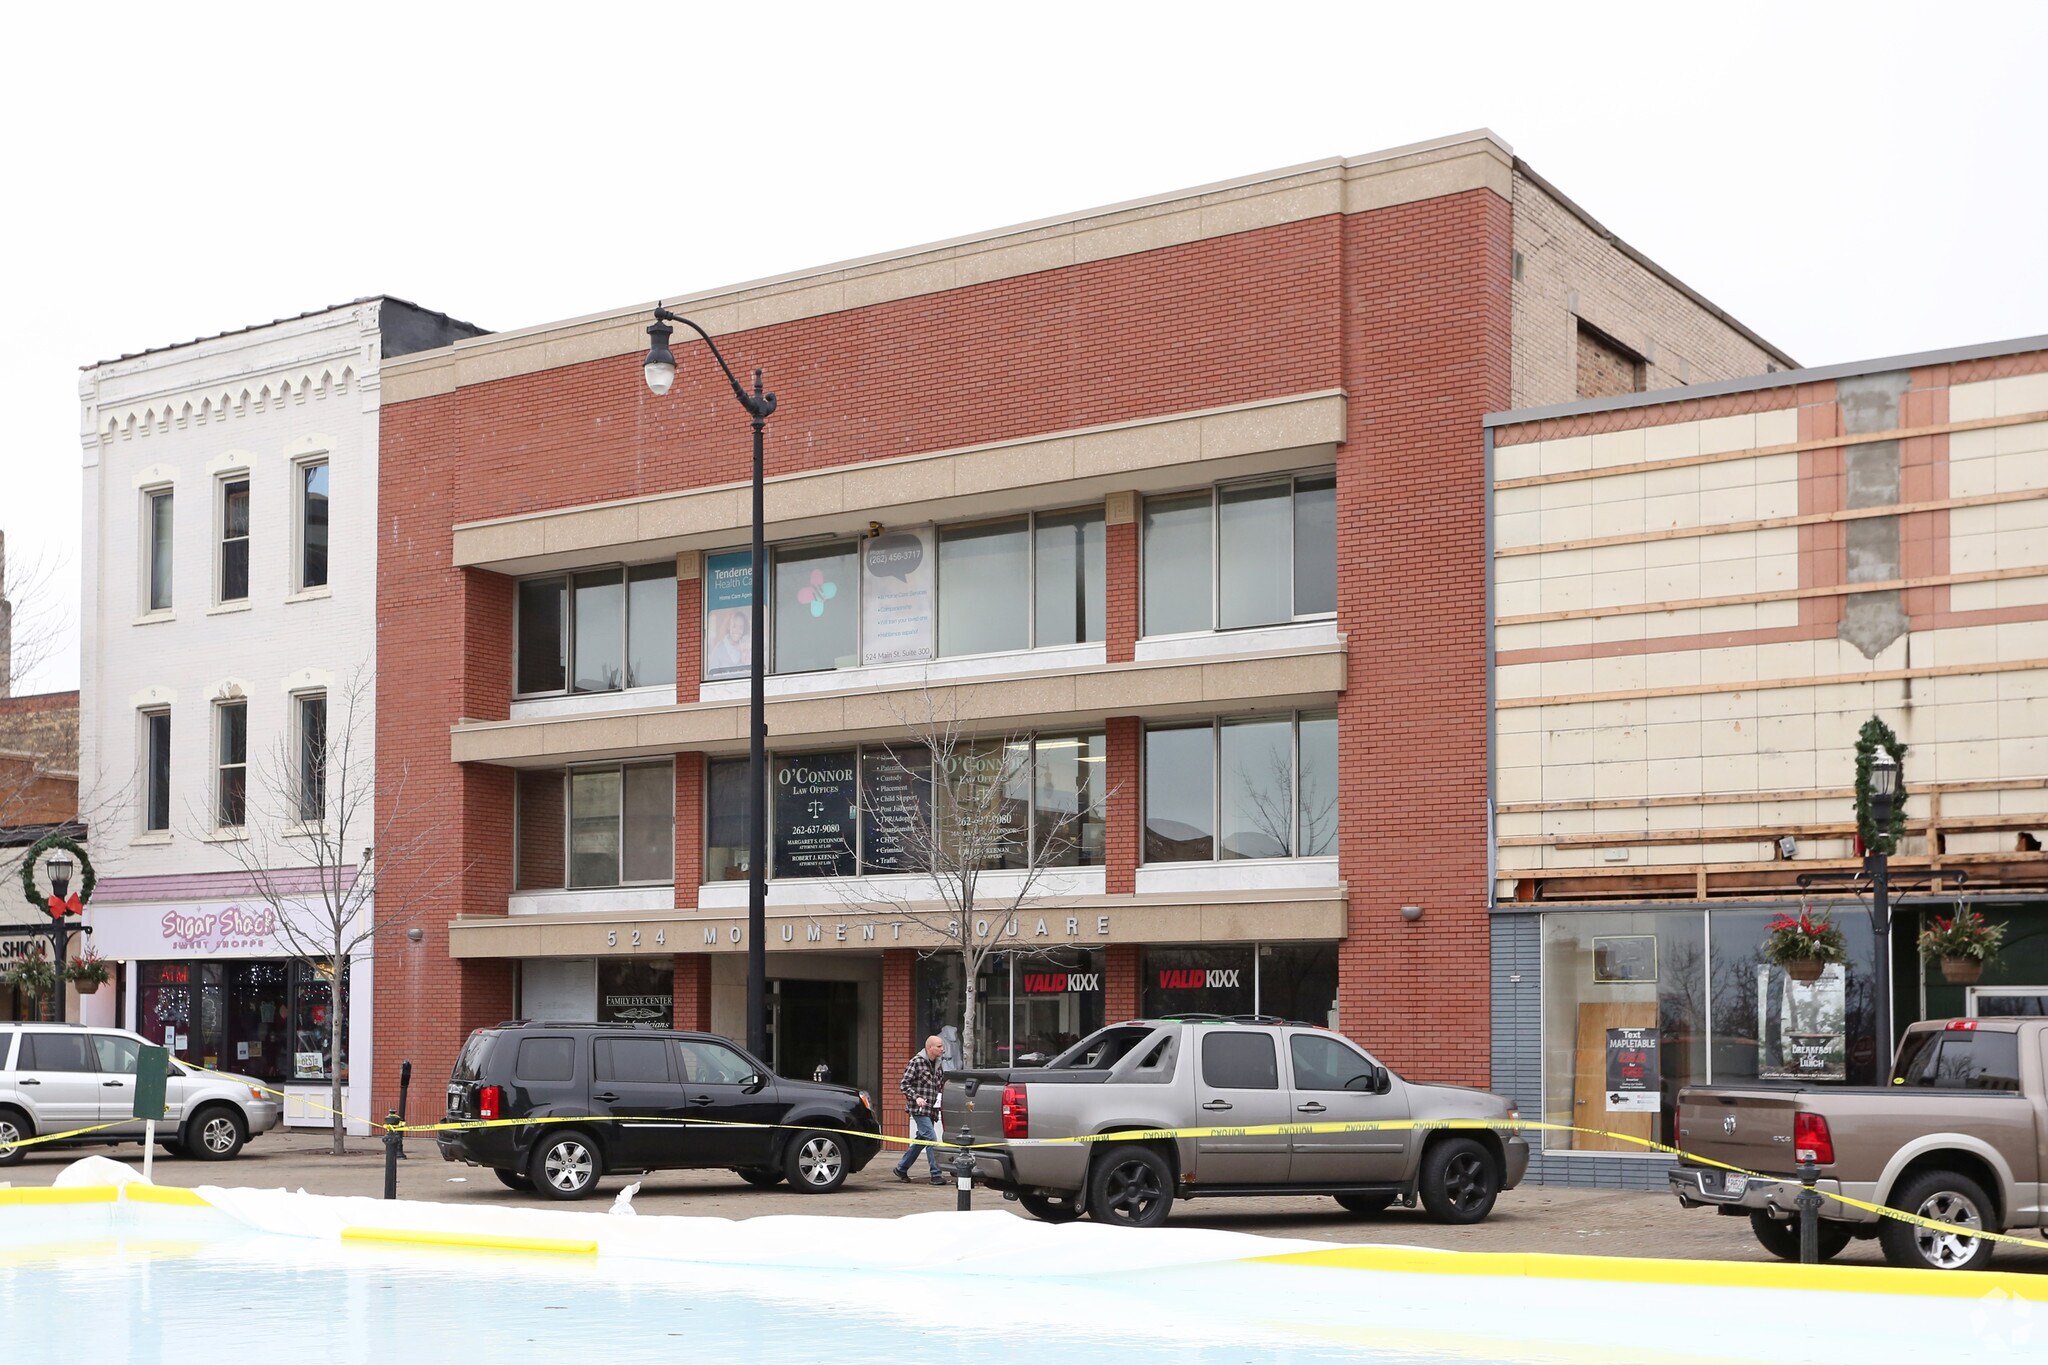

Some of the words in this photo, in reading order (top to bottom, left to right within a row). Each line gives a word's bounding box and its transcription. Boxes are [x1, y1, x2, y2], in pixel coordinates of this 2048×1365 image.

[869, 554, 888, 566] (262)
[889, 550, 921, 561] 456-3717
[714, 567, 753, 580] Tenderne
[714, 578, 741, 590] Health
[742, 576, 753, 586] Ca
[865, 653, 877, 661] 524
[878, 651, 893, 660] Main
[902, 649, 917, 657] Suite
[918, 647, 930, 656] 300
[880, 774, 902, 783] Custody
[792, 824, 840, 835] 262-637-9080
[162, 909, 218, 942] Sugar
[219, 906, 276, 936] Shack
[607, 928, 666, 947] 524
[703, 922, 904, 944] MOUMENT
[948, 915, 1110, 938] SQUARE
[172, 940, 209, 950] SWEET
[216, 939, 264, 949] SHOPPE
[160, 964, 188, 983] ATM
[606, 995, 631, 1005] FAMILY
[632, 996, 645, 1005] EYE
[645, 996, 673, 1005] CENTER
[1623, 1031, 1641, 1039] Text
[1610, 1039, 1656, 1048] MAPLETABLE
